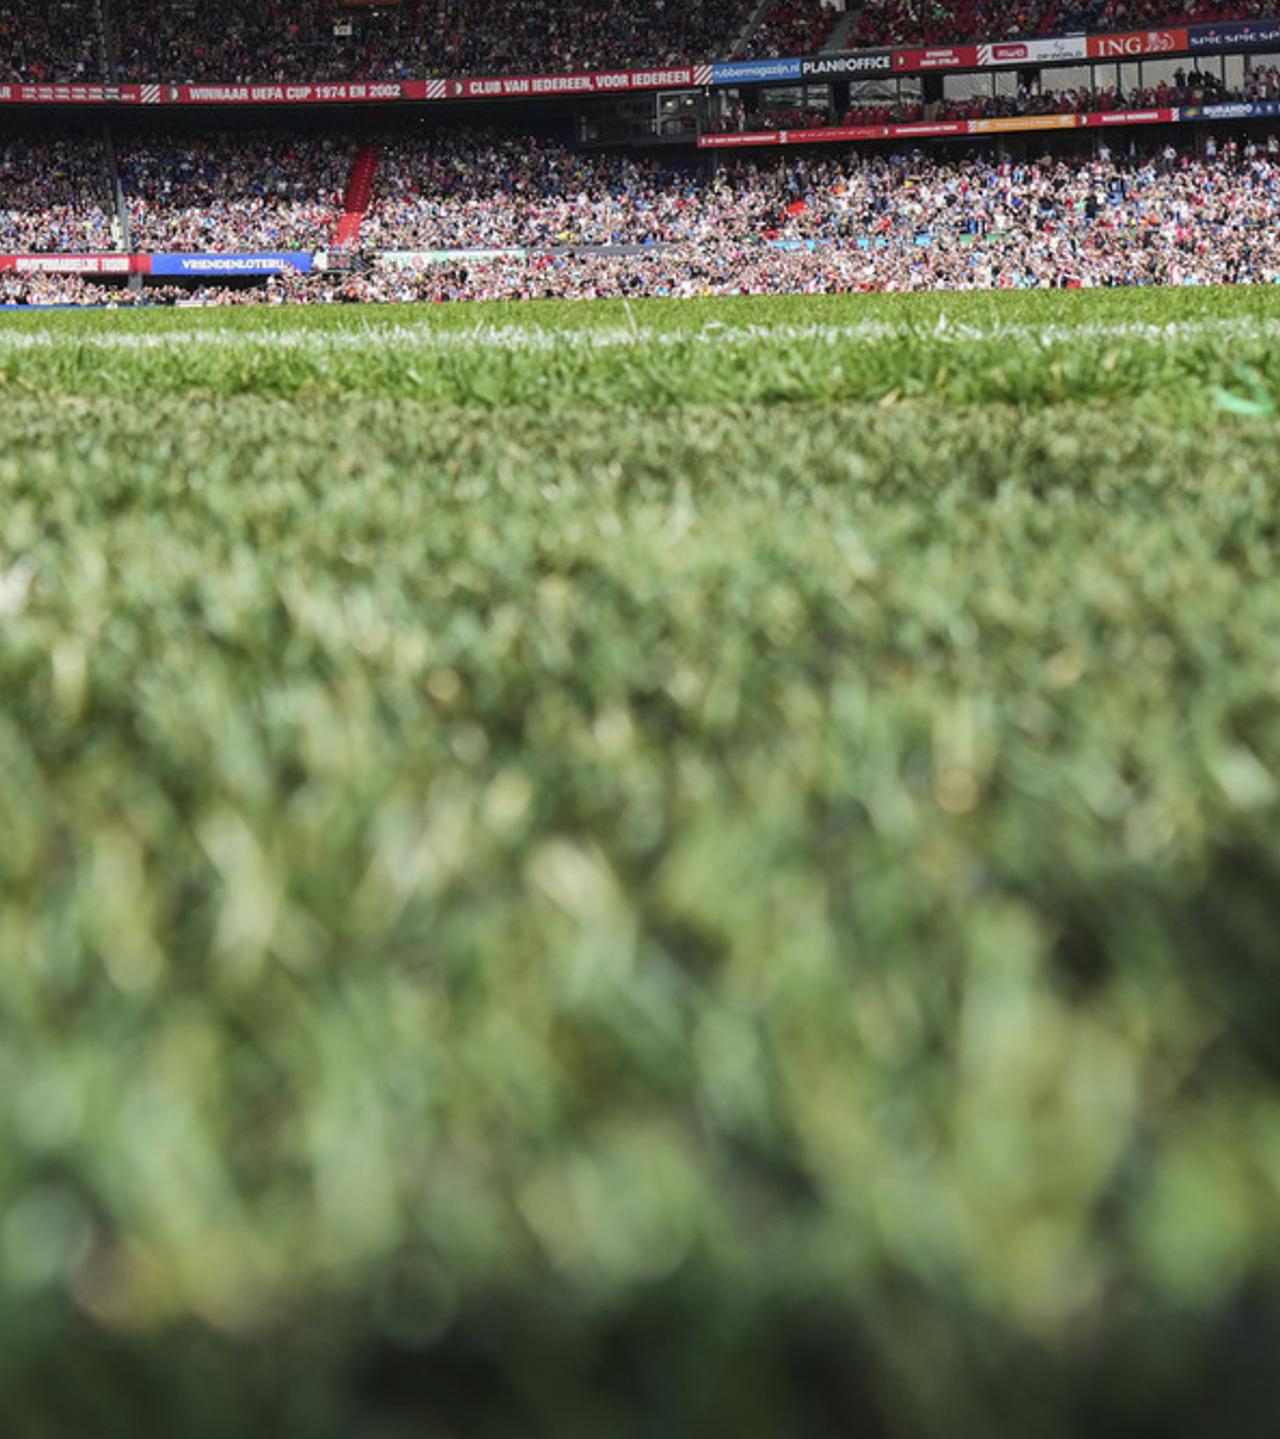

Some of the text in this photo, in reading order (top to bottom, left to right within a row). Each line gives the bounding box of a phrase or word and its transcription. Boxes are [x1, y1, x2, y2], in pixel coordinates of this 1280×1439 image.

[1098, 38, 1142, 57] ING
[470, 81, 501, 95] CLUB
[504, 79, 529, 92] VAN
[595, 73, 629, 88] VOOR
[631, 70, 690, 86] IEDEREEN
[189, 85, 401, 101] WINNAAR UEFA CUP 1974 EN 2002
